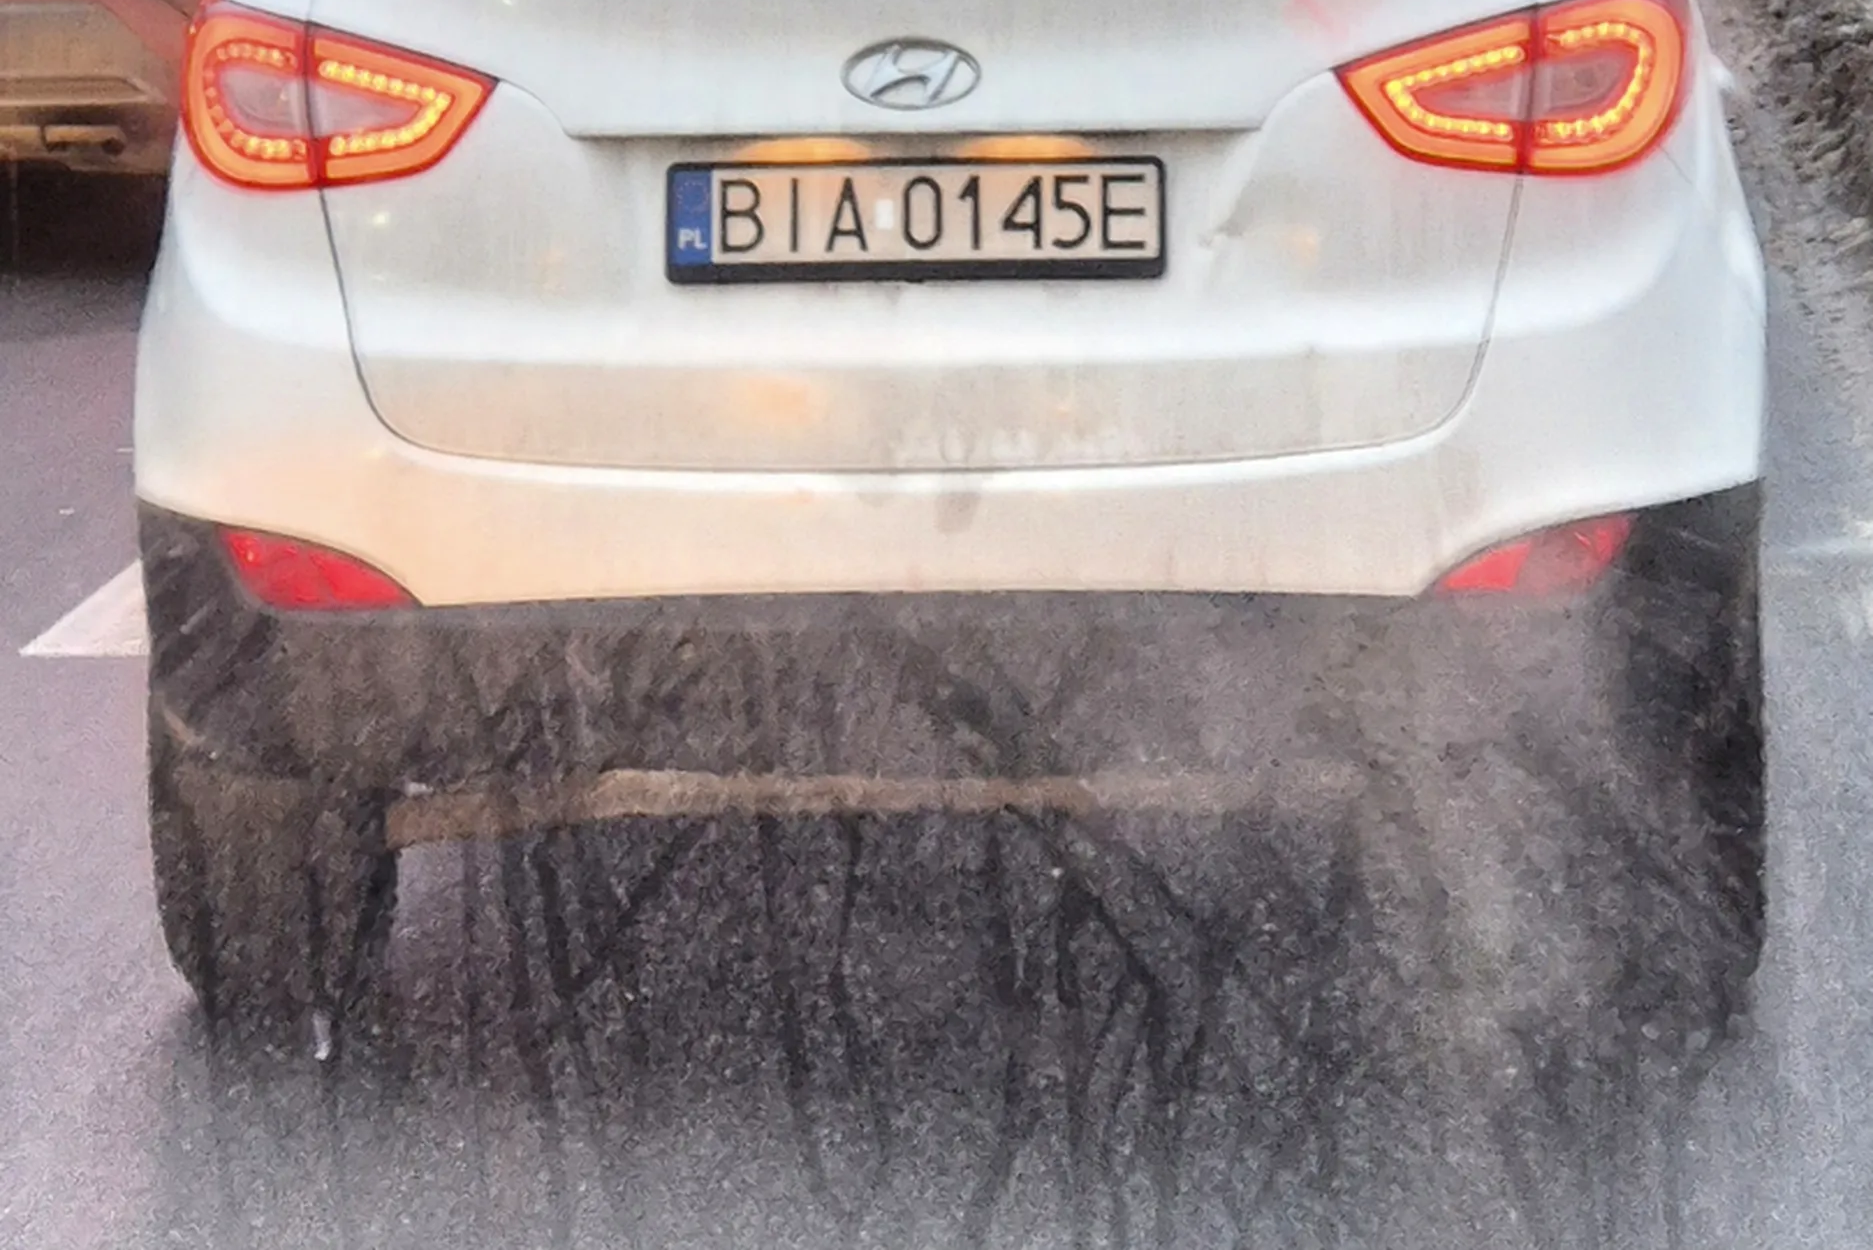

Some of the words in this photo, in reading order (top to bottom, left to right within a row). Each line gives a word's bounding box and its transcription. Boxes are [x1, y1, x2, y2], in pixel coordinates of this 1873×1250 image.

[678, 227, 708, 250] PL
[720, 176, 869, 254] BIA
[903, 174, 1146, 251] 0145E
